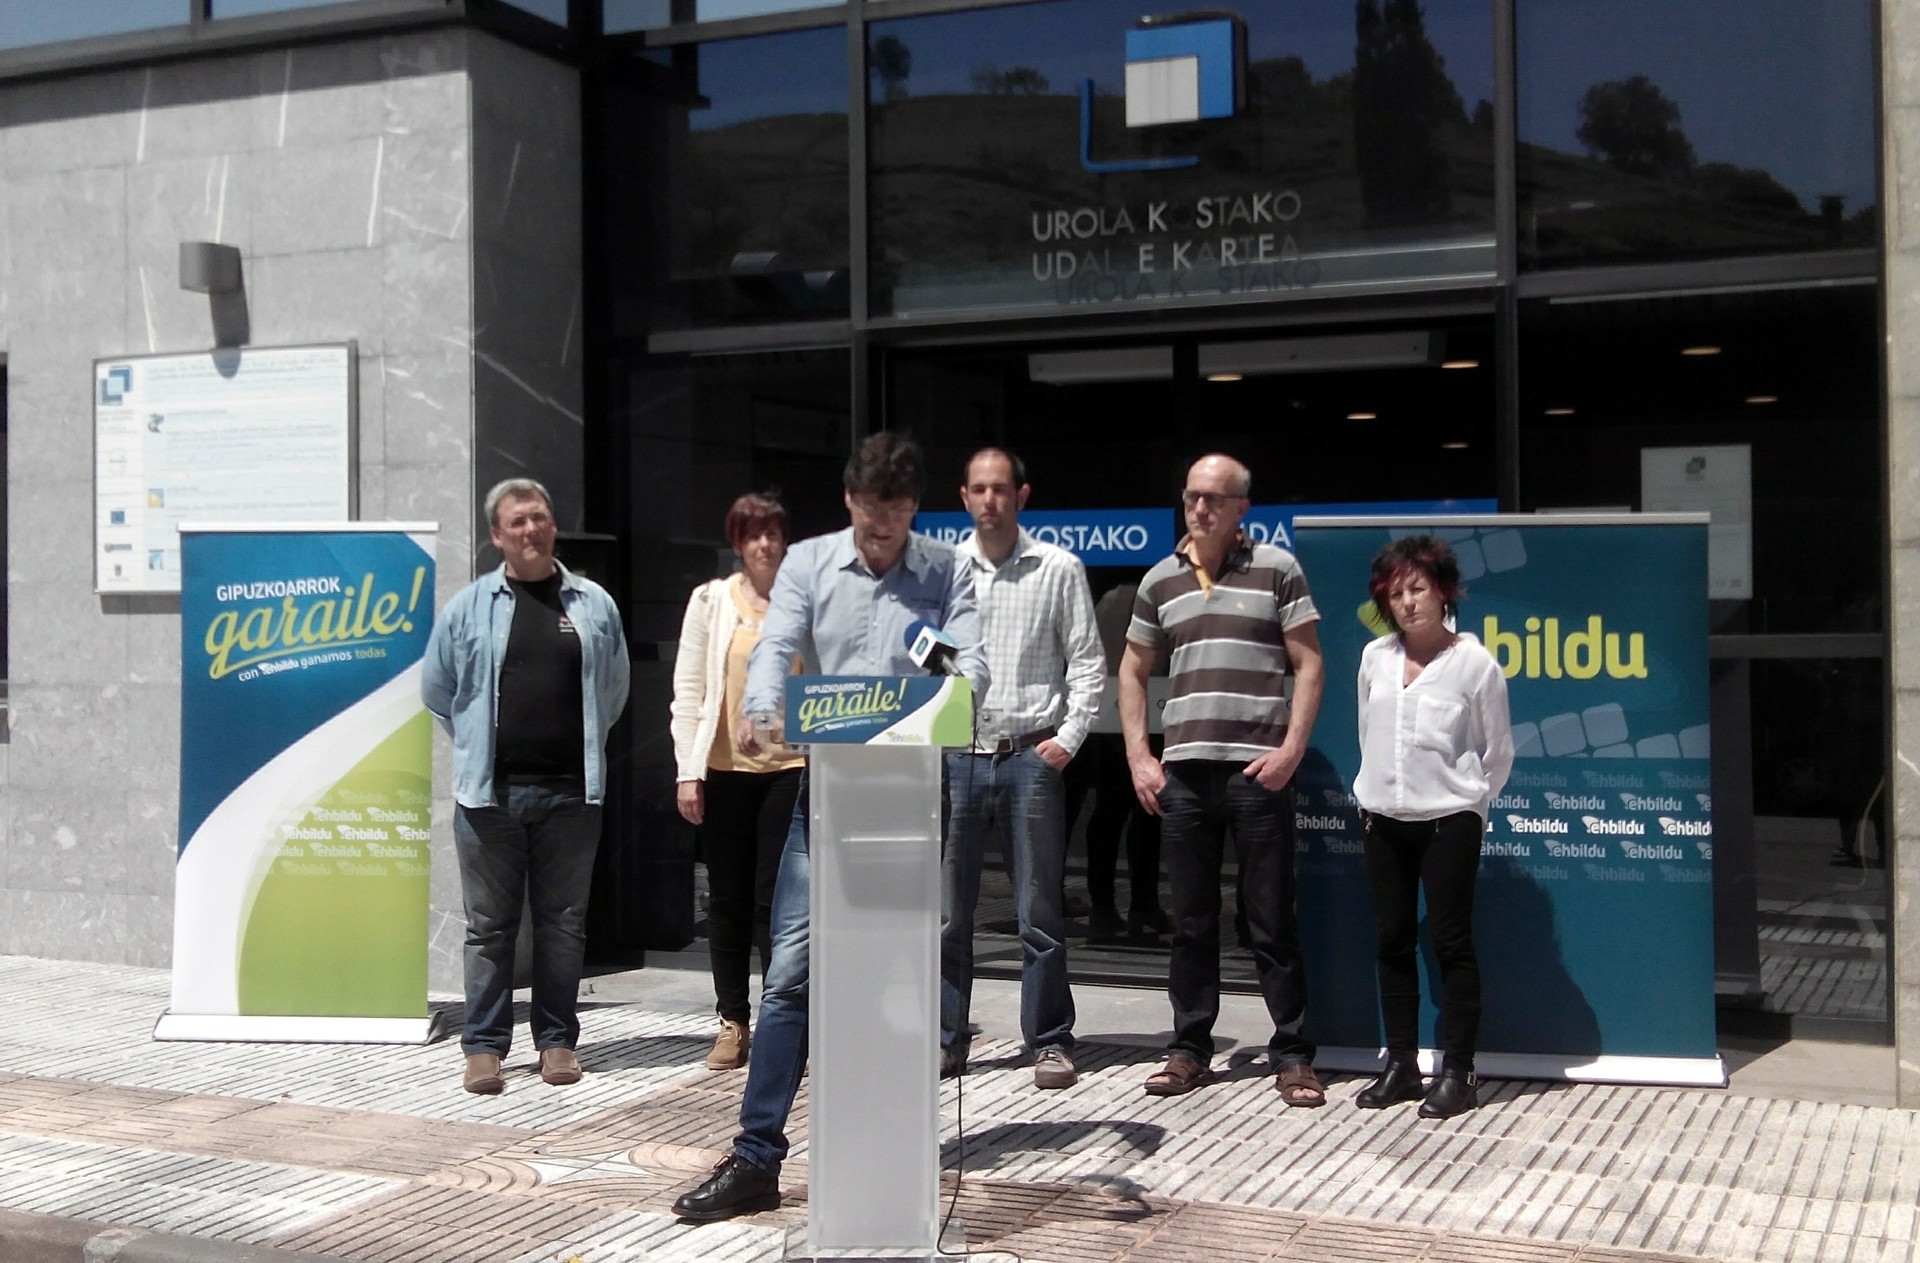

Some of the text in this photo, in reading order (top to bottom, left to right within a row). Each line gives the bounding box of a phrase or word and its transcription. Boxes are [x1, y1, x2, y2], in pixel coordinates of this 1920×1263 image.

[1032, 189, 1302, 242] UROLA KSTAKO
[1032, 232, 1300, 282] UDAL EKARTEA
[1027, 524, 1148, 552] OSTAKO
[216, 577, 341, 601] GIPUZKOARROK
[204, 566, 426, 680] garaile!
[1484, 615, 1648, 680] bildu
[238, 668, 259, 681] con
[300, 650, 352, 669] ganamos
[355, 647, 387, 659] todas
[804, 682, 866, 695] GIPUZKOARROK
[798, 677, 908, 733] garaile!
[1552, 795, 1606, 810] ehbildu
[1628, 796, 1683, 811] ehbildu
[288, 827, 332, 840] ehbildu
[344, 828, 388, 841] ehbildu
[1295, 815, 1712, 836] ehbildu ehbildu ehbildu ehbild
[1553, 843, 1606, 858] ehbildu
[1628, 844, 1683, 860] ehbildu
